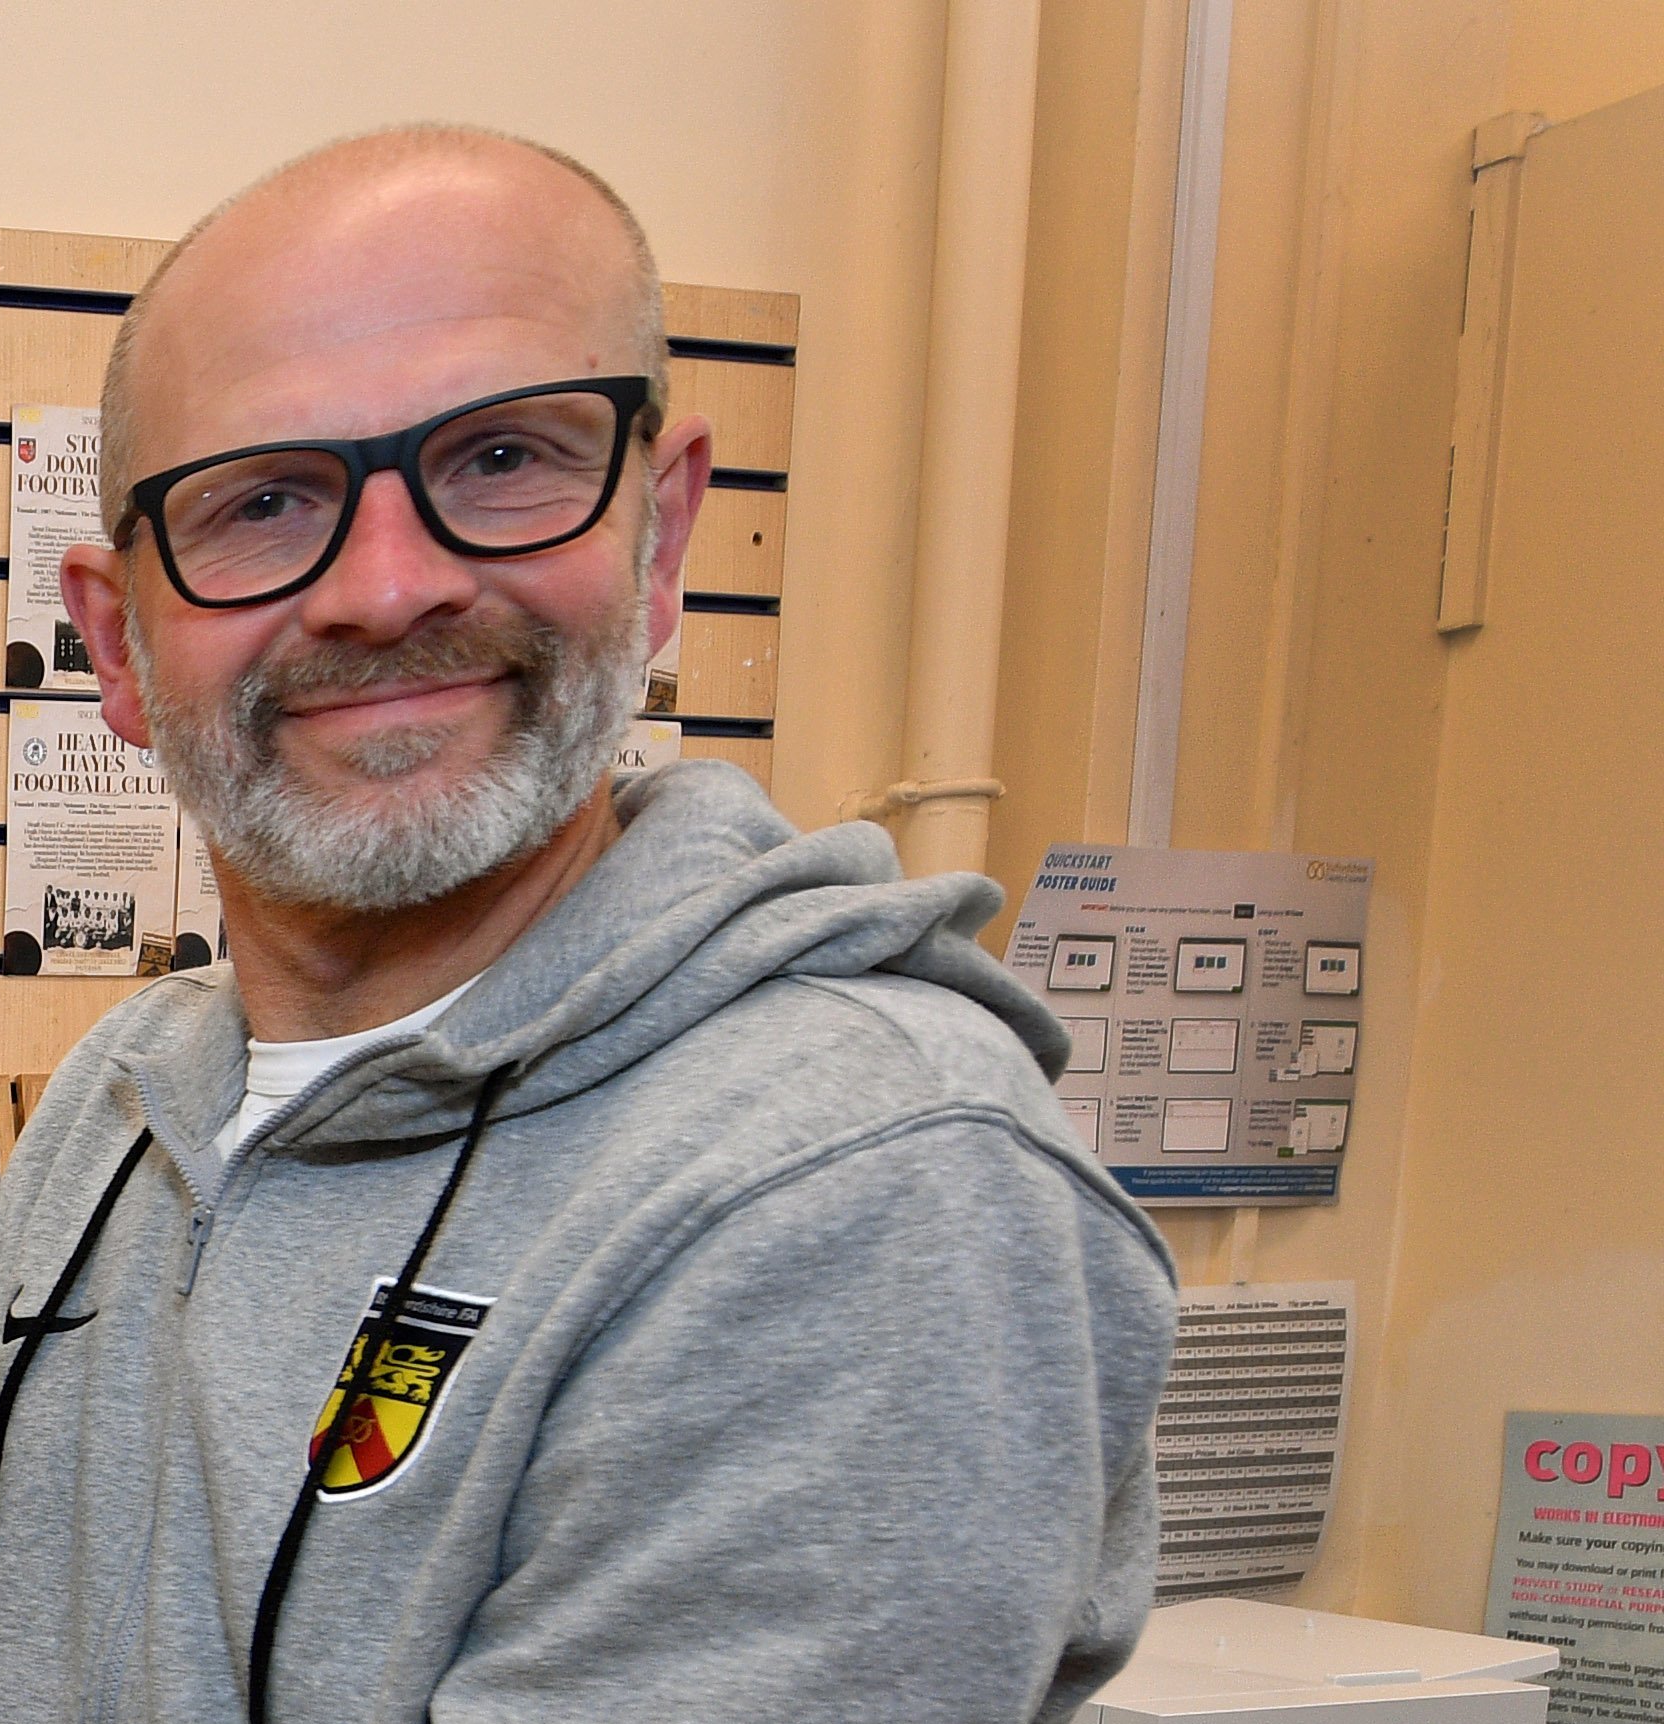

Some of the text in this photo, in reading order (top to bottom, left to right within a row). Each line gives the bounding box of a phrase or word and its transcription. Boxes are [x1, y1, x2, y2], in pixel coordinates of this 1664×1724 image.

[66, 434, 101, 454] STO
[47, 454, 97, 475] DOMI
[17, 474, 100, 496] FOOTBA
[58, 733, 125, 752] HEATH
[62, 754, 125, 772] HAYES
[14, 773, 116, 793] FOOTBALL
[1045, 853, 1113, 870] QUICKSTART
[1036, 875, 1117, 893] POSTER GUIDE
[1534, 1507, 1664, 1528] WORKS IN ELECTRON
[1519, 1530, 1664, 1556] Make sure your copyin
[1517, 1558, 1657, 1580] You may download or print
[1514, 1576, 1664, 1599] PRIVATE STUDY RESEA
[1512, 1591, 1664, 1614] NON-COMMERCIAL PURP
[1509, 1610, 1664, 1634] without asking permission fro
[1507, 1629, 1576, 1647] Please note
